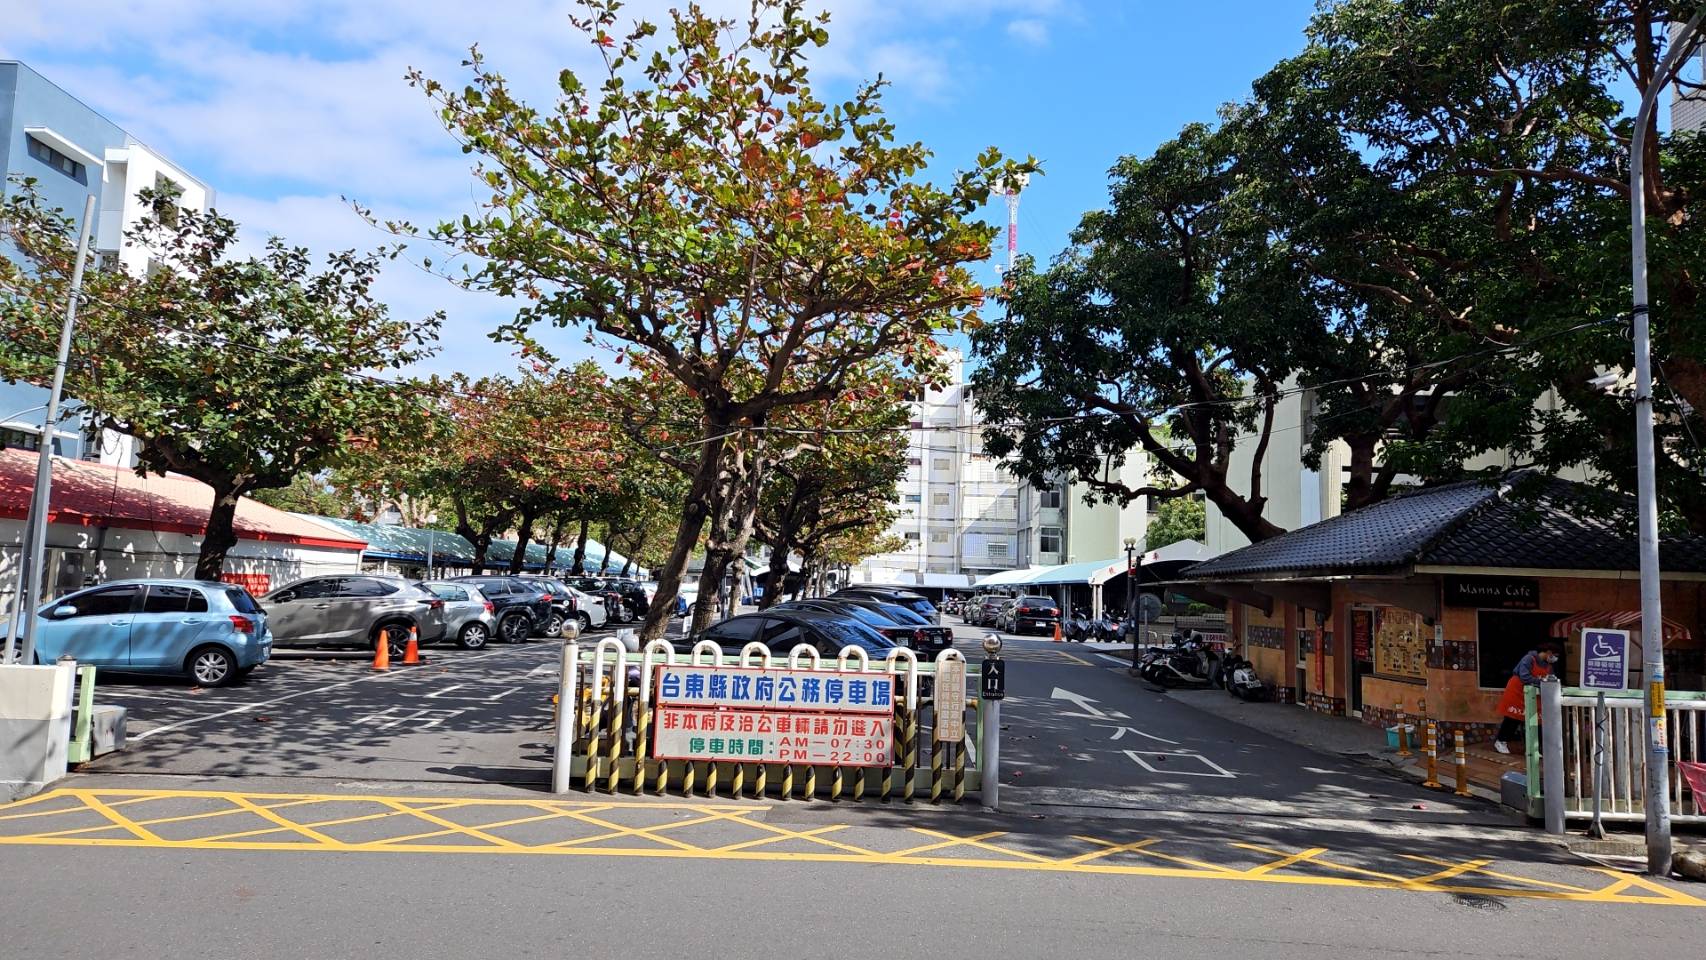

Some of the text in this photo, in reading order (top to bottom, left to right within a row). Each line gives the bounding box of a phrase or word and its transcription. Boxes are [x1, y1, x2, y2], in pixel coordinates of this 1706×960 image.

[1459, 584, 1531, 597] Manna Cafe
[662, 672, 890, 705] 台東縣政府公務停車場
[988, 662, 999, 690] 入口
[664, 713, 886, 737] 非本府及洽公車輛請勿進入
